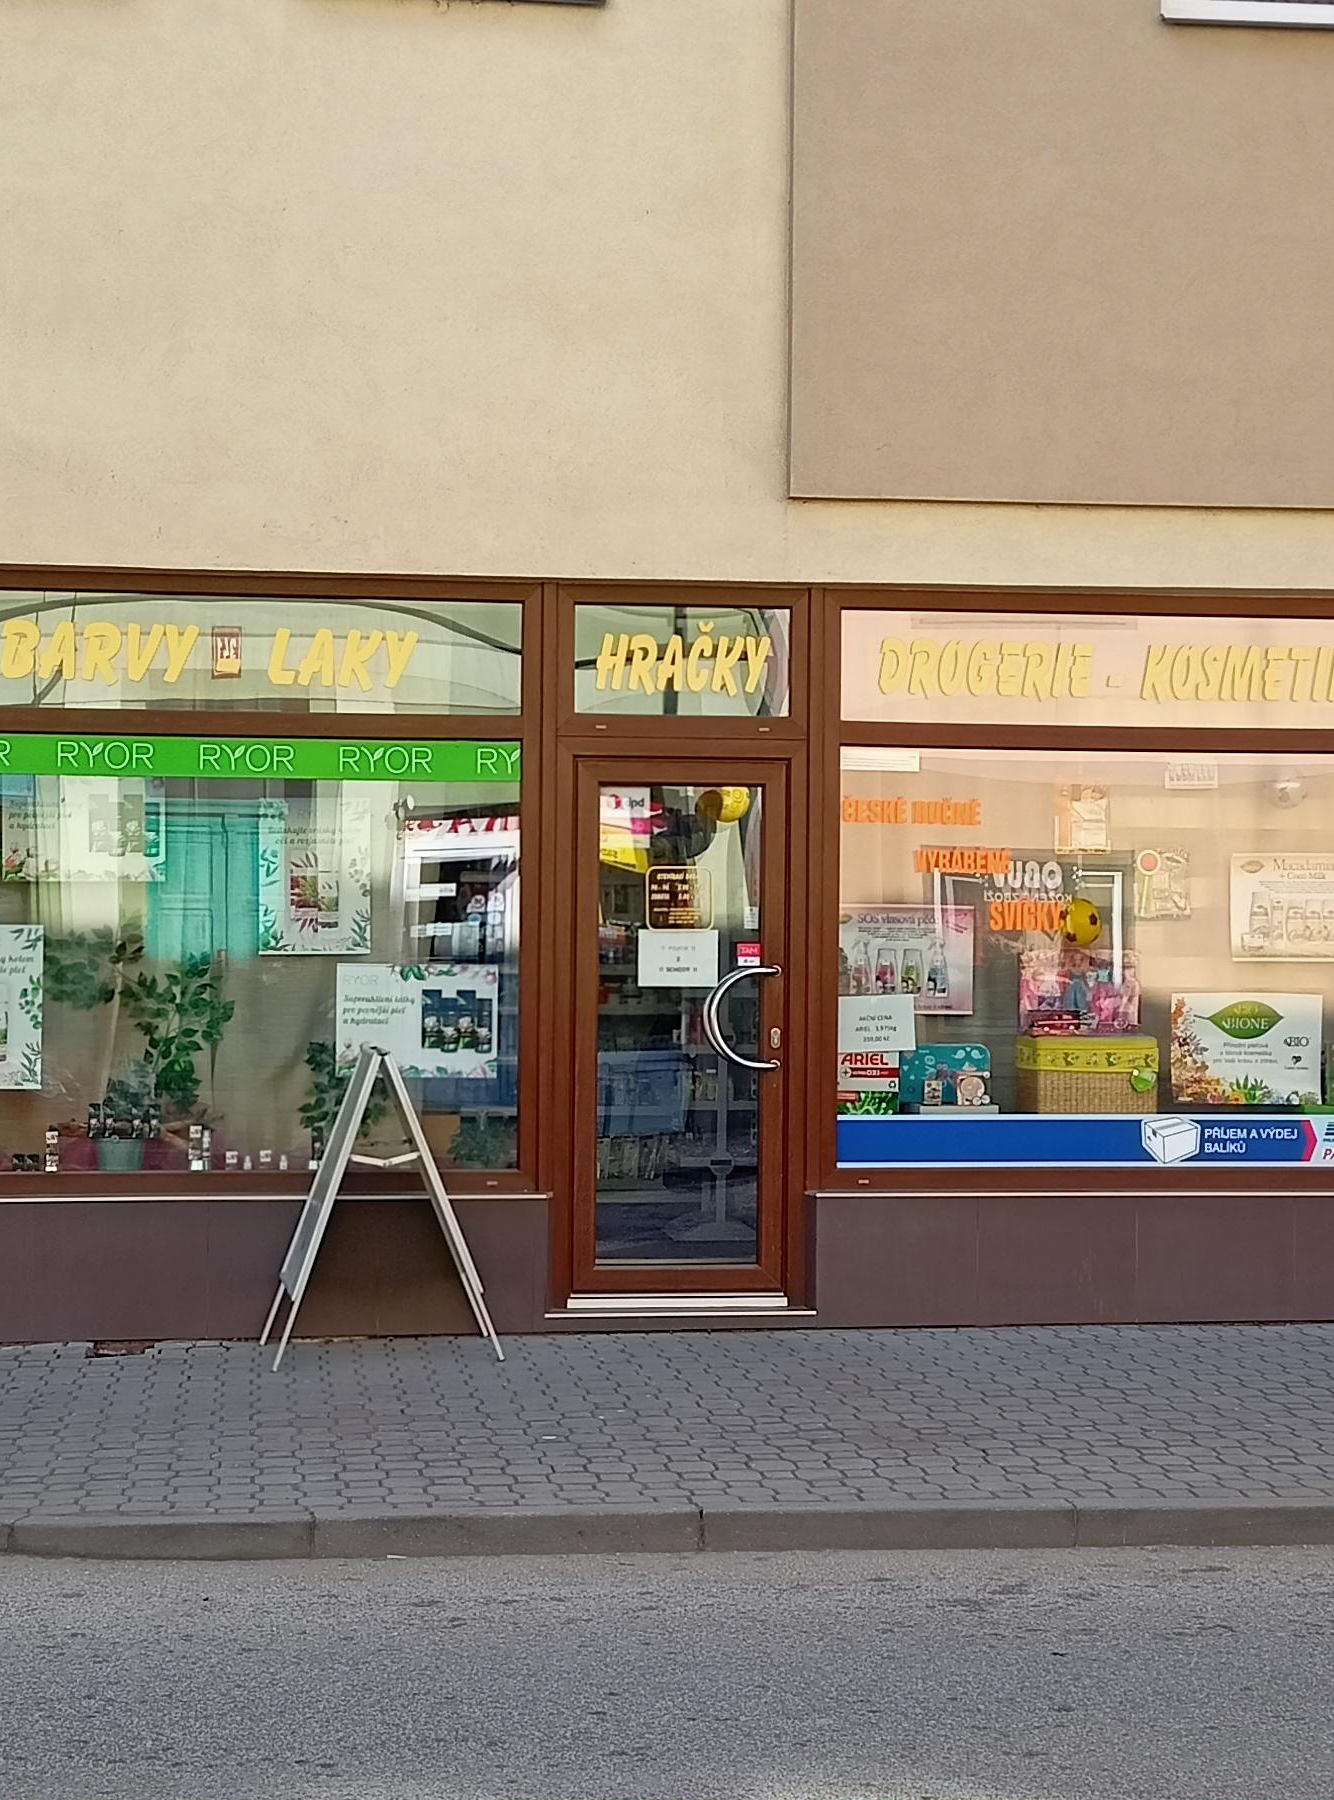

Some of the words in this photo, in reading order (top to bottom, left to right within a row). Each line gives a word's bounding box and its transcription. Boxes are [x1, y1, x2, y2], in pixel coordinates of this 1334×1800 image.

[0, 619, 199, 685] BARVY
[268, 627, 419, 691] LAKY
[596, 621, 770, 696] HRAČKY
[878, 638, 1094, 701] DROGERIE
[57, 741, 154, 770] RYOR
[199, 744, 295, 772] RYOR
[339, 747, 432, 774] RYOR
[857, 913, 880, 924] SOS
[841, 1053, 889, 1066] ARIEL
[1204, 1126, 1247, 1139] PŘÍJEM
[1250, 1128, 1260, 1139] A
[1261, 1126, 1298, 1140] VÝDEJ
[1204, 1140, 1246, 1154] BALÍKŮ
